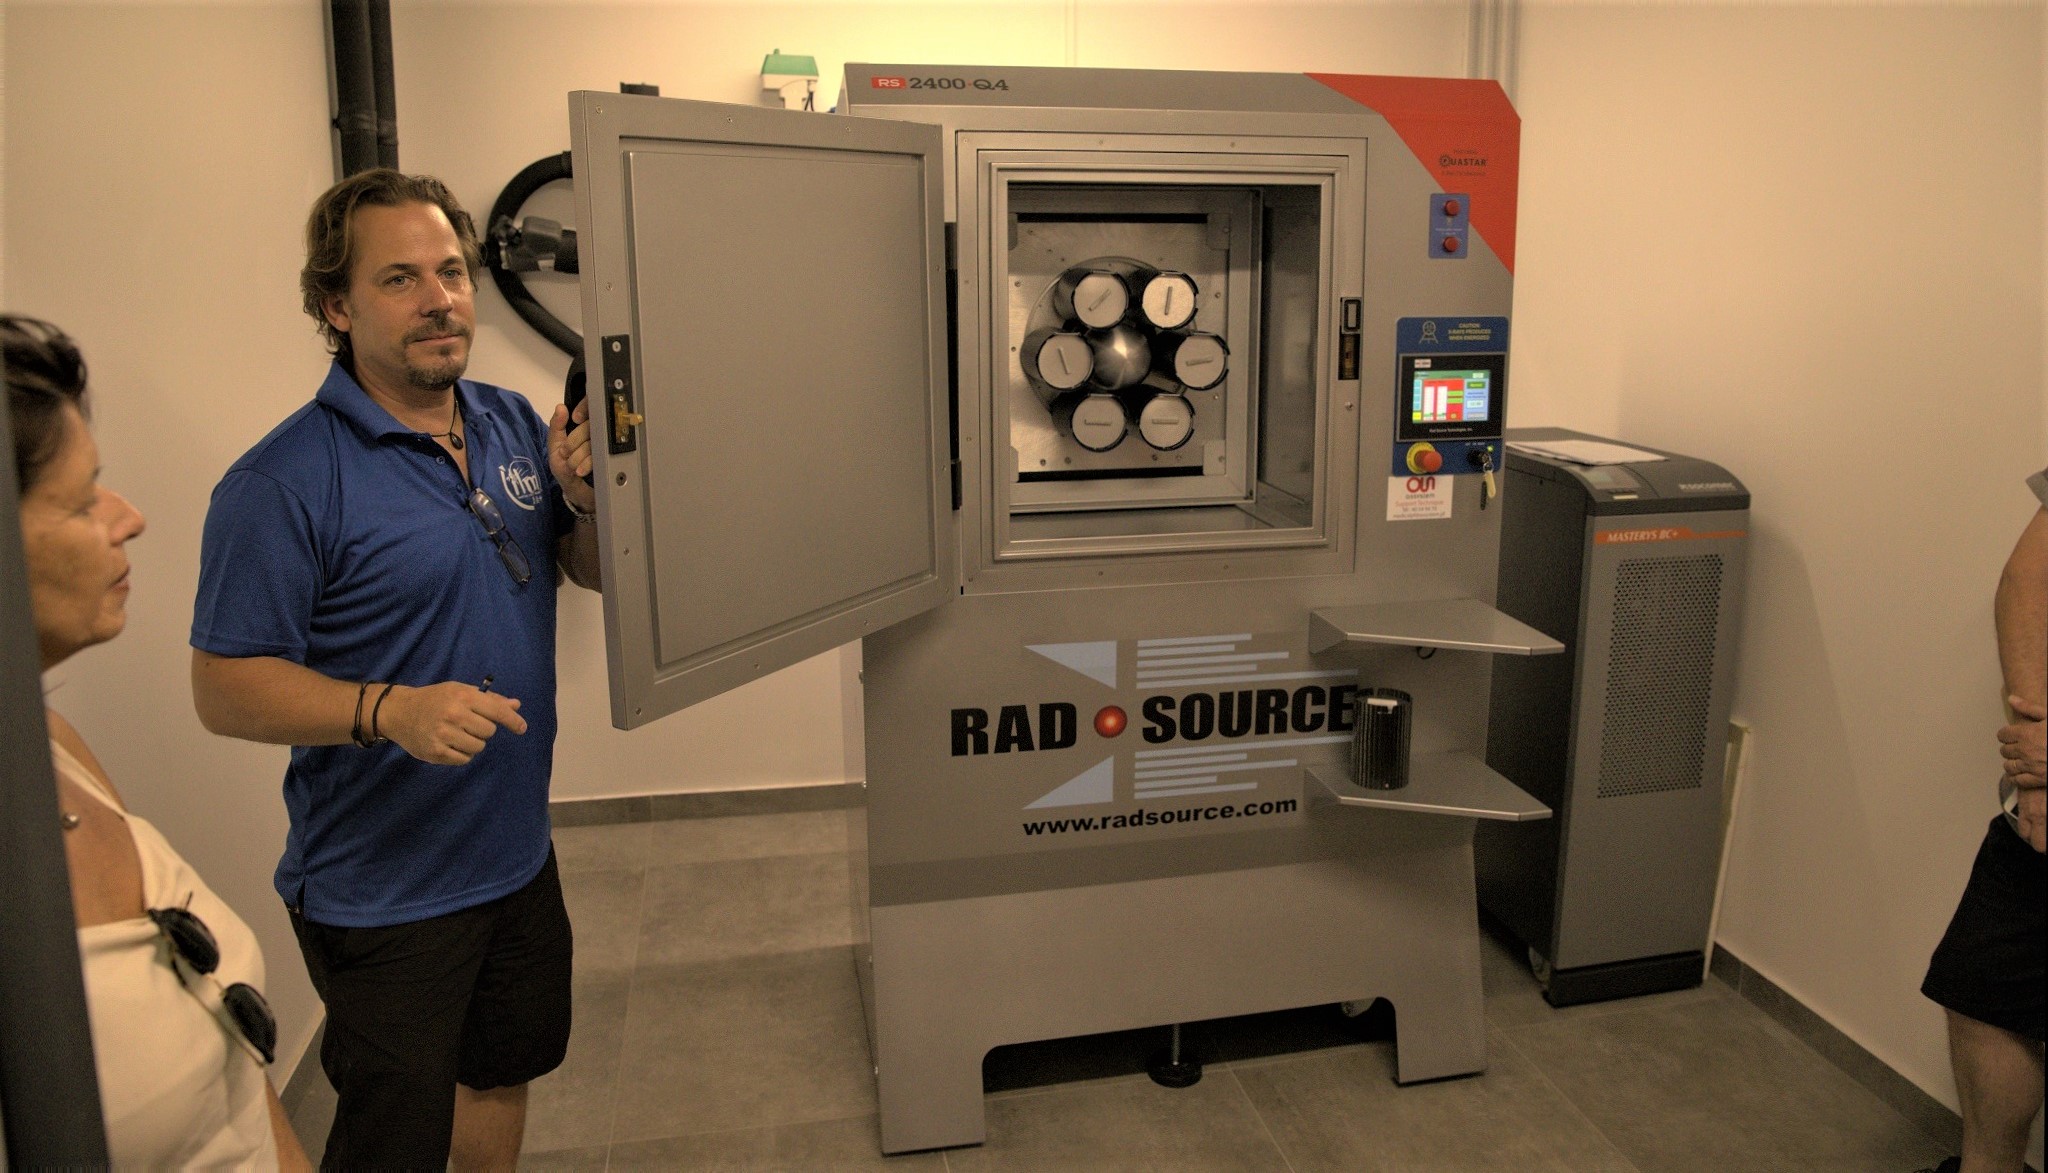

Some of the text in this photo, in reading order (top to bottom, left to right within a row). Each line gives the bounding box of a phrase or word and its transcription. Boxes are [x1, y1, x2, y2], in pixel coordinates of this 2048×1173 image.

[878, 78, 901, 88] RS
[1607, 529, 1657, 542] MASTERYS
[950, 685, 1358, 757] RAD SOURCE
[1022, 798, 1298, 836] www.radsource.com
